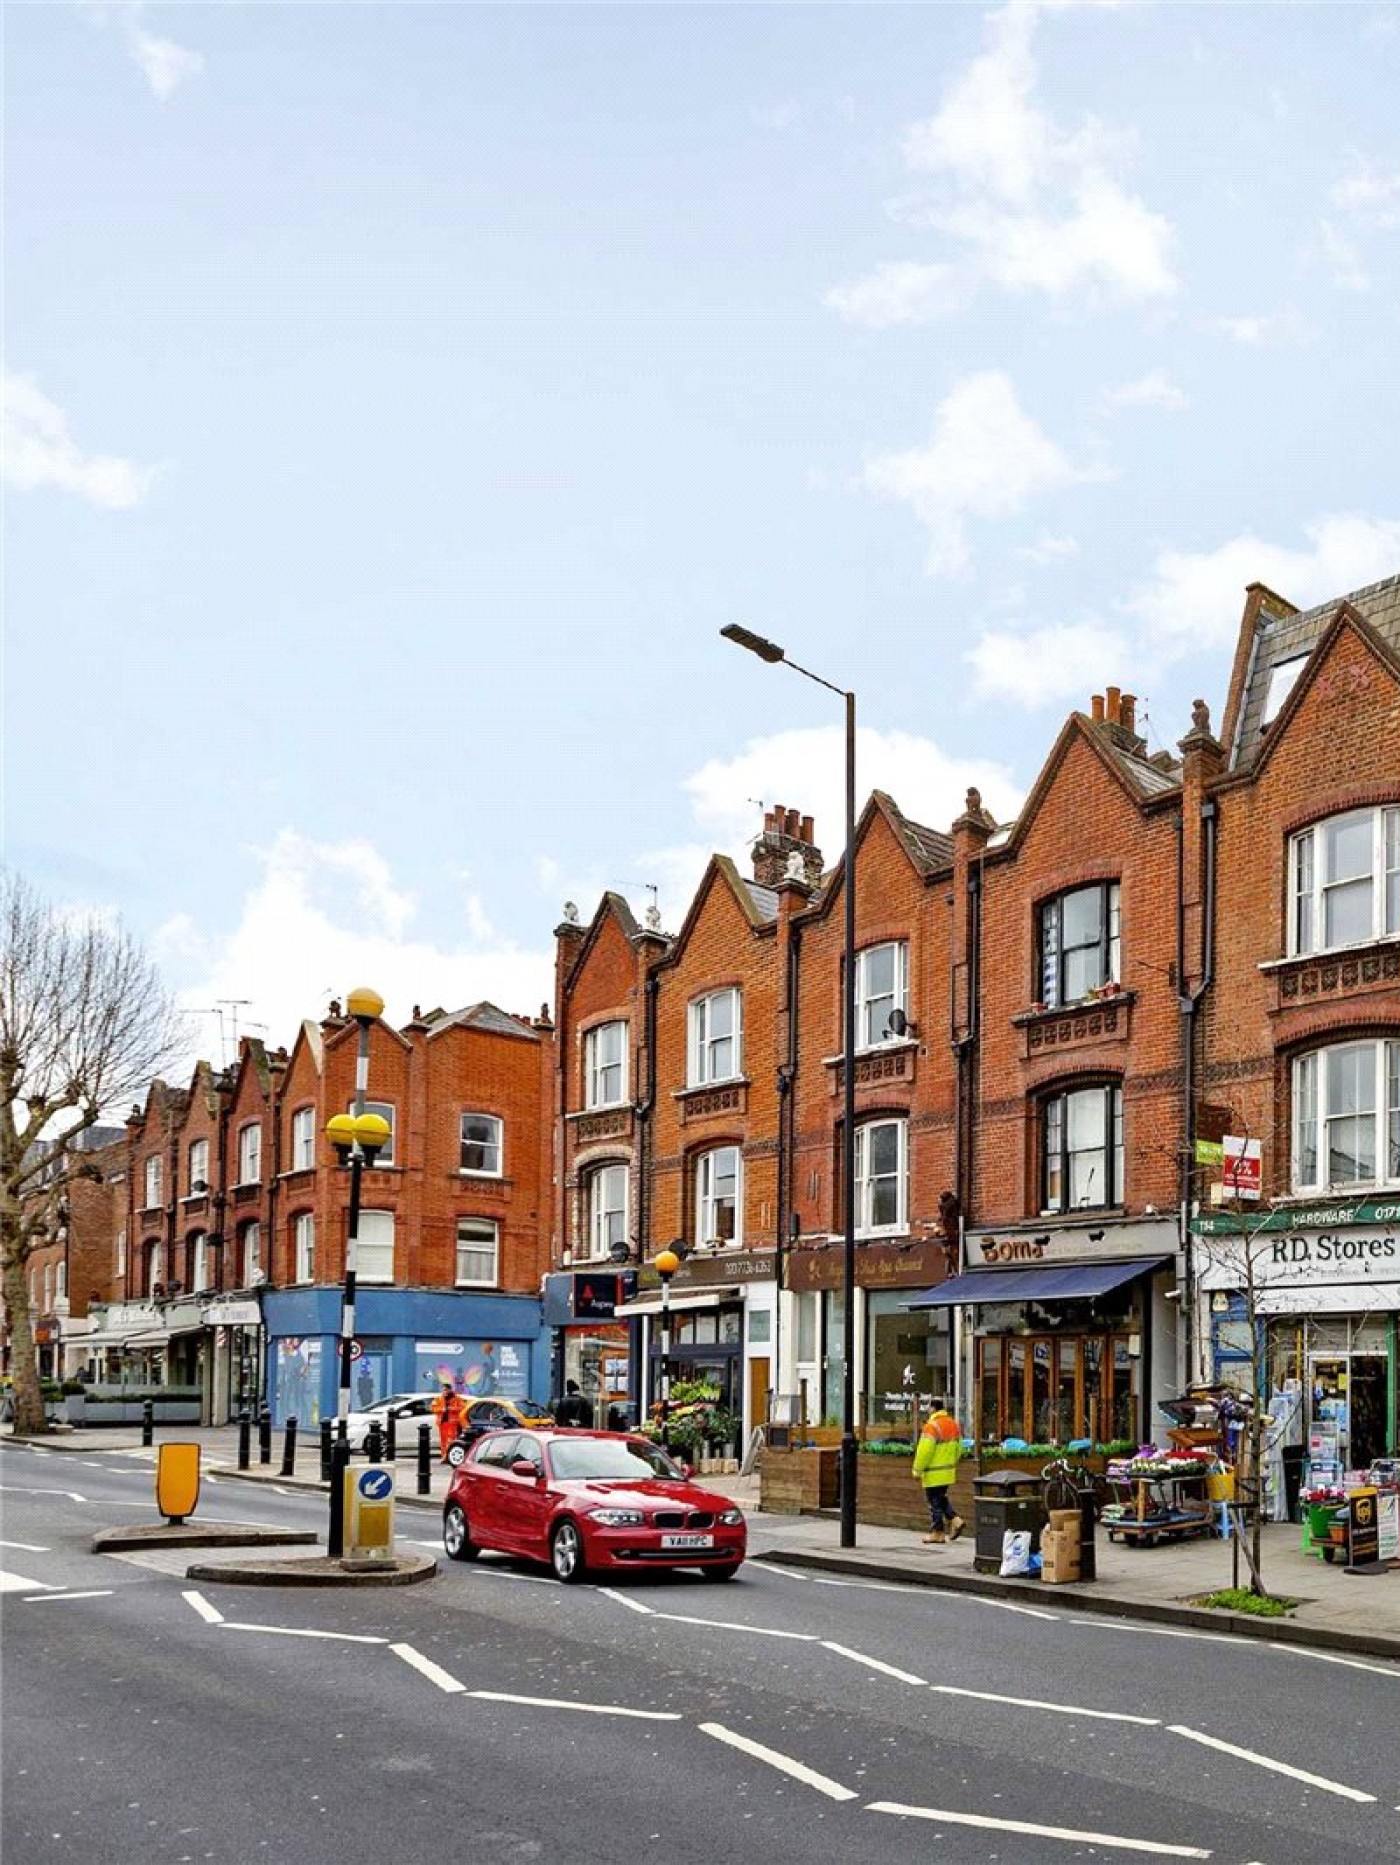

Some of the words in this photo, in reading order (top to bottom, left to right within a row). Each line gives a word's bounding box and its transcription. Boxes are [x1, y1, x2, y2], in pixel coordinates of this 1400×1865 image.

[1292, 1209, 1355, 1227] HARDWARE
[1374, 1206, 1400, 1220] 0171
[1316, 1233, 1396, 1261] Stores
